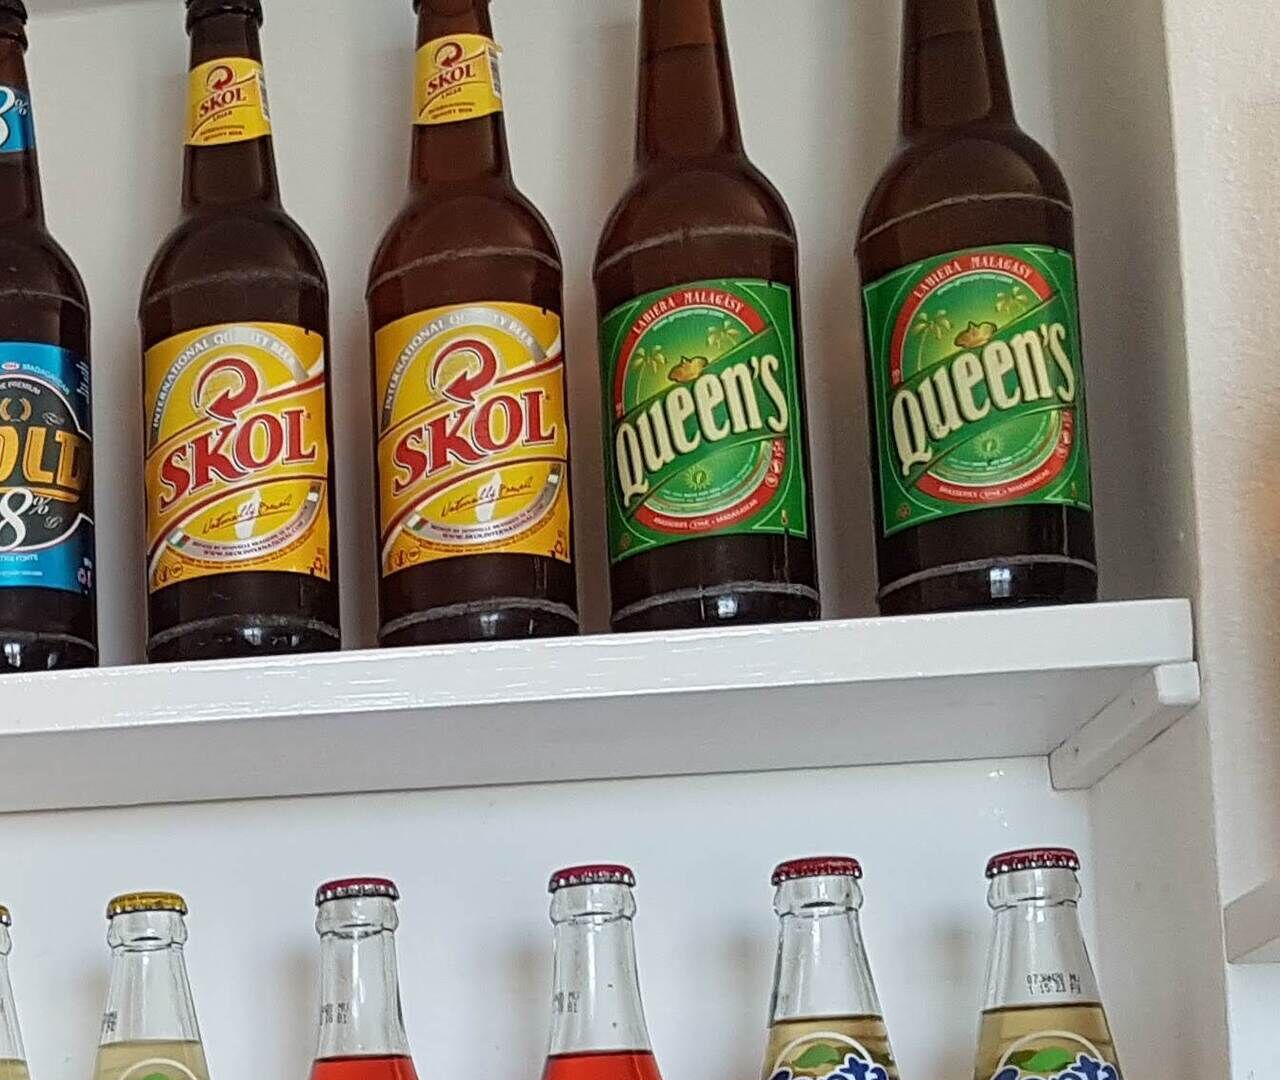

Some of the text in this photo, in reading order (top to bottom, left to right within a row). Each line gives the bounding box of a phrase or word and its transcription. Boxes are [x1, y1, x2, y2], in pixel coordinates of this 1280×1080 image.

[199, 88, 247, 117] SKOL
[427, 64, 476, 95] SKOL
[683, 291, 744, 313] MALAGASY
[971, 256, 1034, 279] MALAGASY
[153, 340, 209, 429] INTERNATIONAL
[385, 320, 443, 410] INTERNATIONAL
[891, 322, 1075, 477] Queen's
[159, 409, 318, 514] SKOL
[393, 390, 555, 496] SKOL
[615, 354, 789, 508] Queen's
